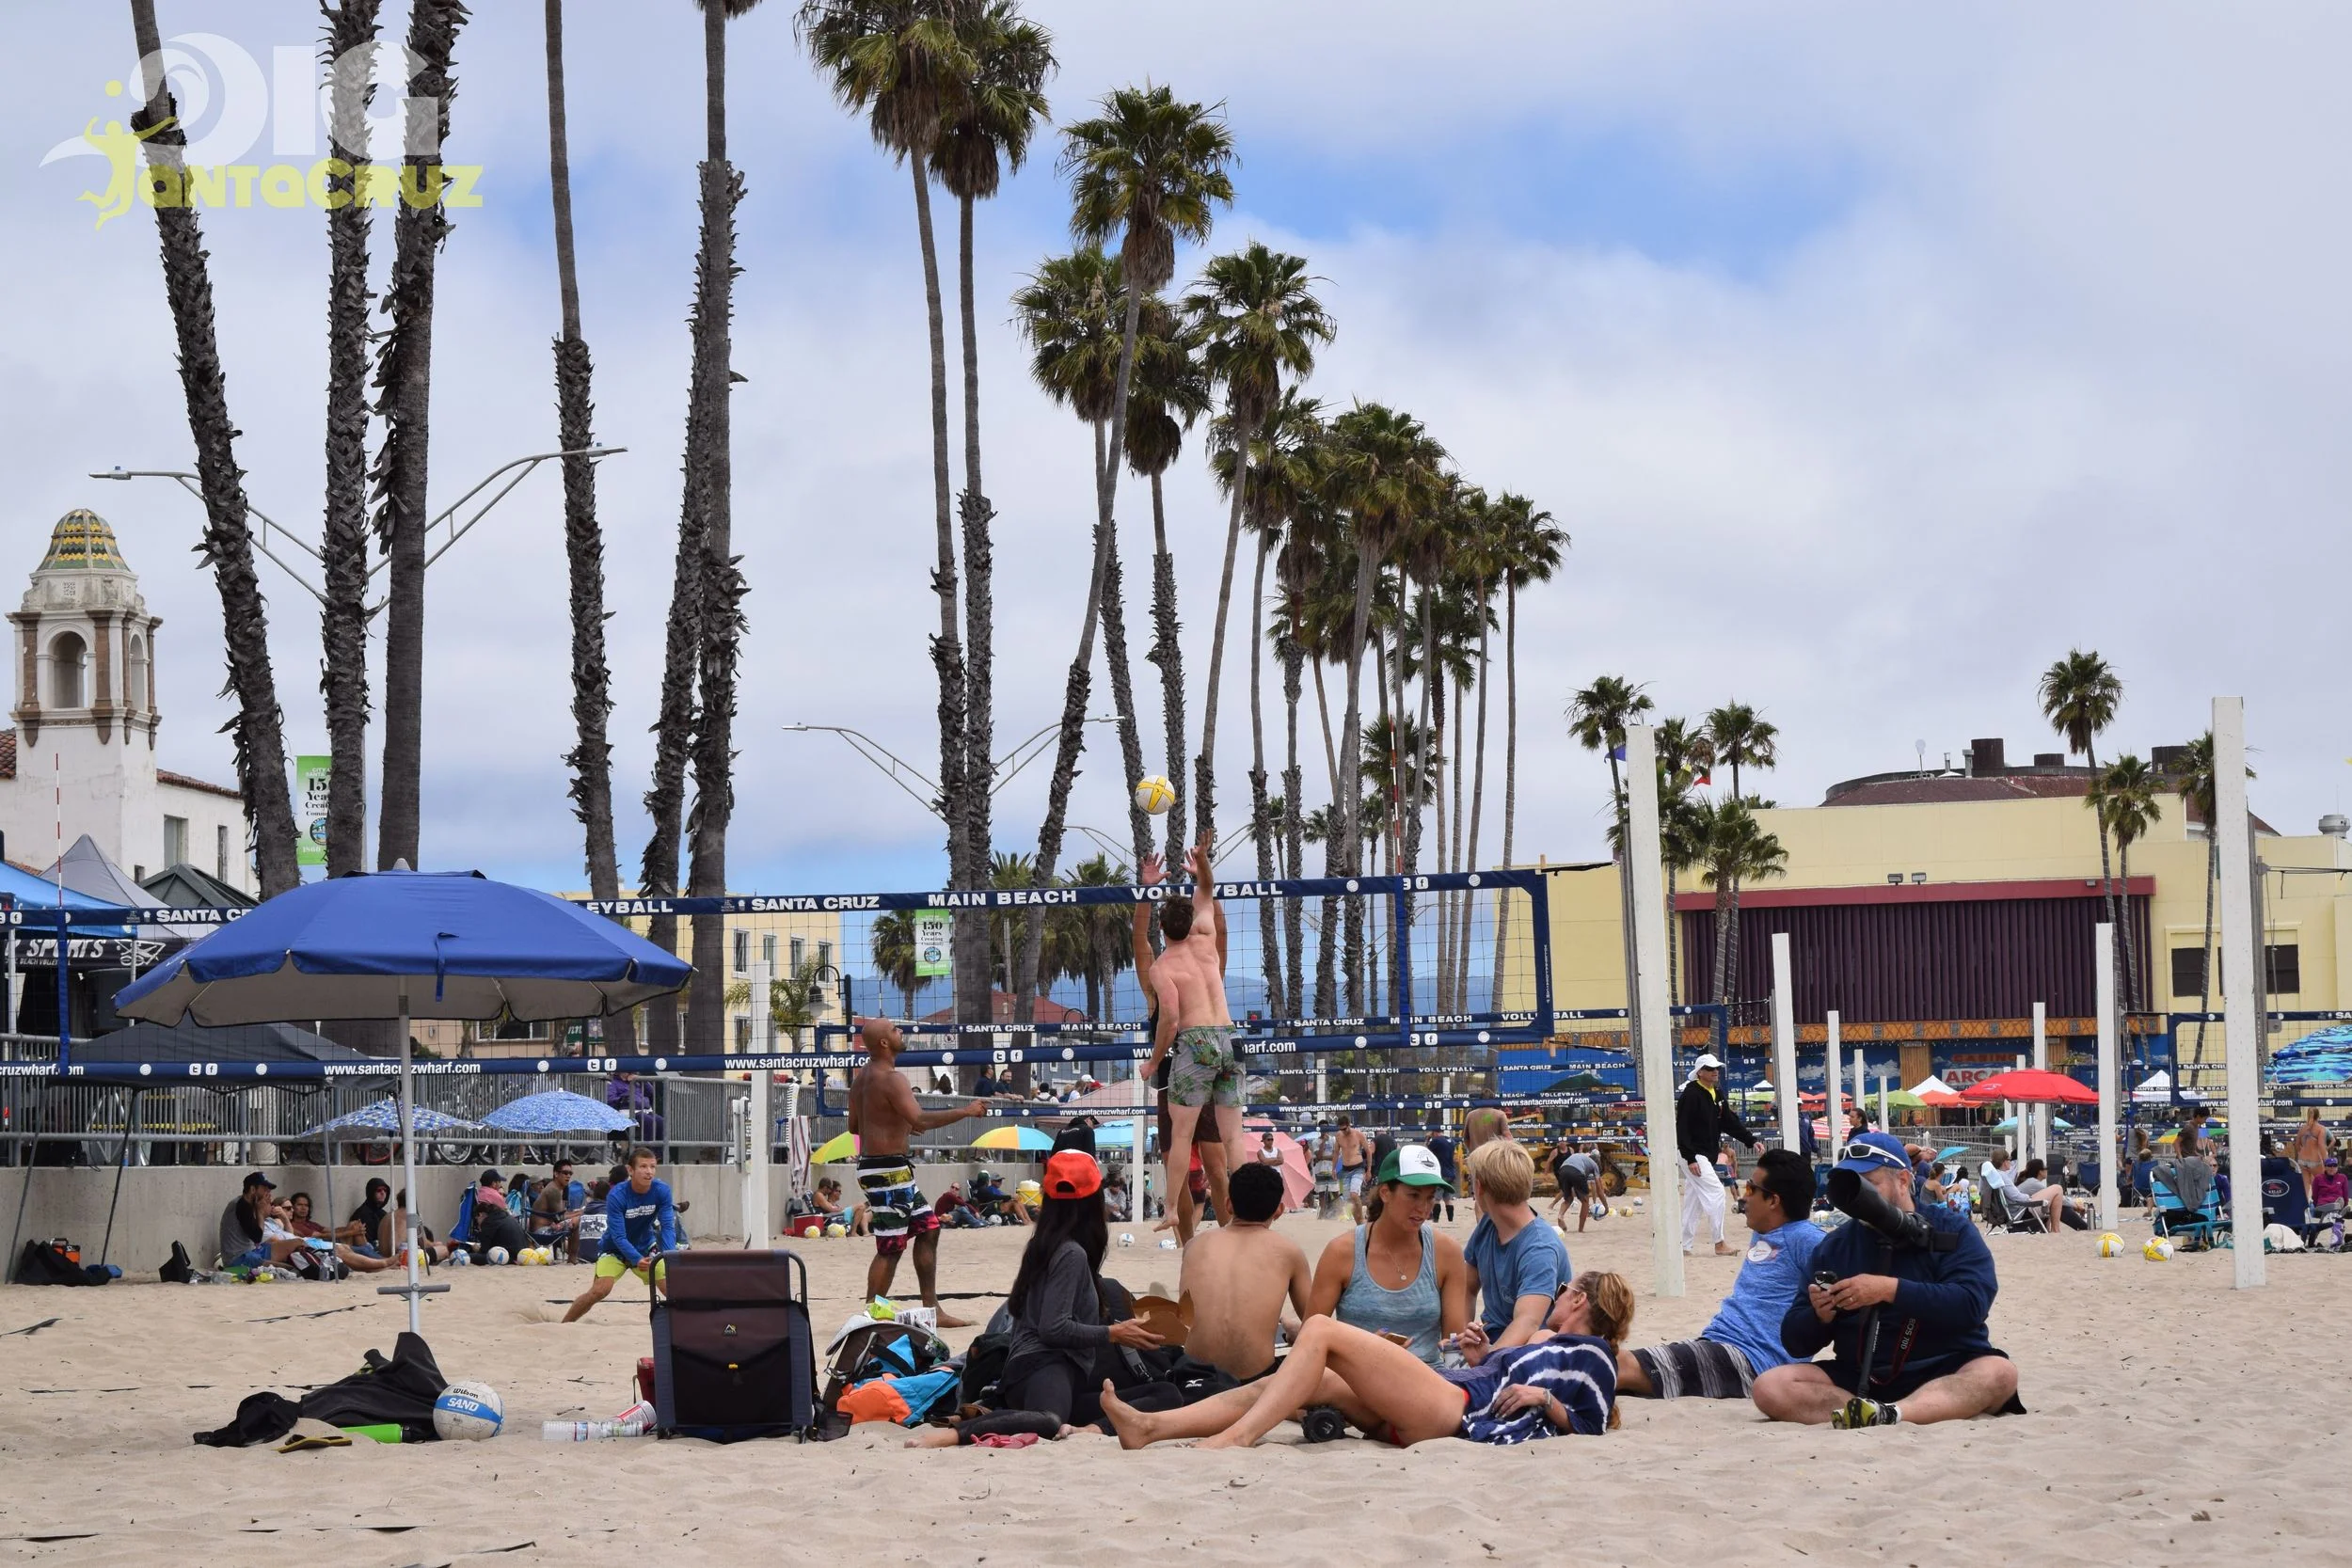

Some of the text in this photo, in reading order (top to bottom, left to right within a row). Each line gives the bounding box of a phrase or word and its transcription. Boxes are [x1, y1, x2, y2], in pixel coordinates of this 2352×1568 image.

[309, 778, 330, 791] 15
[307, 791, 328, 801] Yea
[752, 896, 818, 911] SANTA
[823, 895, 880, 910] CRUZ
[928, 891, 987, 907] MAIN
[996, 889, 1077, 906] BEACH
[1131, 883, 1283, 901] VOLYBALL
[156, 909, 222, 923] SANTA
[1294, 1019, 1331, 1027] SANTA
[1333, 1018, 1365, 1026] CRUZ
[1390, 1016, 1422, 1024] MIN
[1427, 1015, 1472, 1023] BEACH
[1502, 1011, 1585, 1021] VOLLBALL
[965, 1022, 1141, 1034] SANTA CRUZ MAIN BEACH
[324, 1060, 481, 1075] www.santaczwharf.com
[724, 1053, 871, 1069] www.santacruzwharf.c
[1279, 1103, 1367, 1113] www.santacruzwharf.com
[1500, 1097, 1590, 1107] www.santacruzwharf.com
[1059, 1108, 1147, 1117] www.santacruzwharf.com
[1900, 1318, 1916, 1350] EOS 70D
[453, 1387, 479, 1399] Wilson
[447, 1397, 479, 1412] SAND
